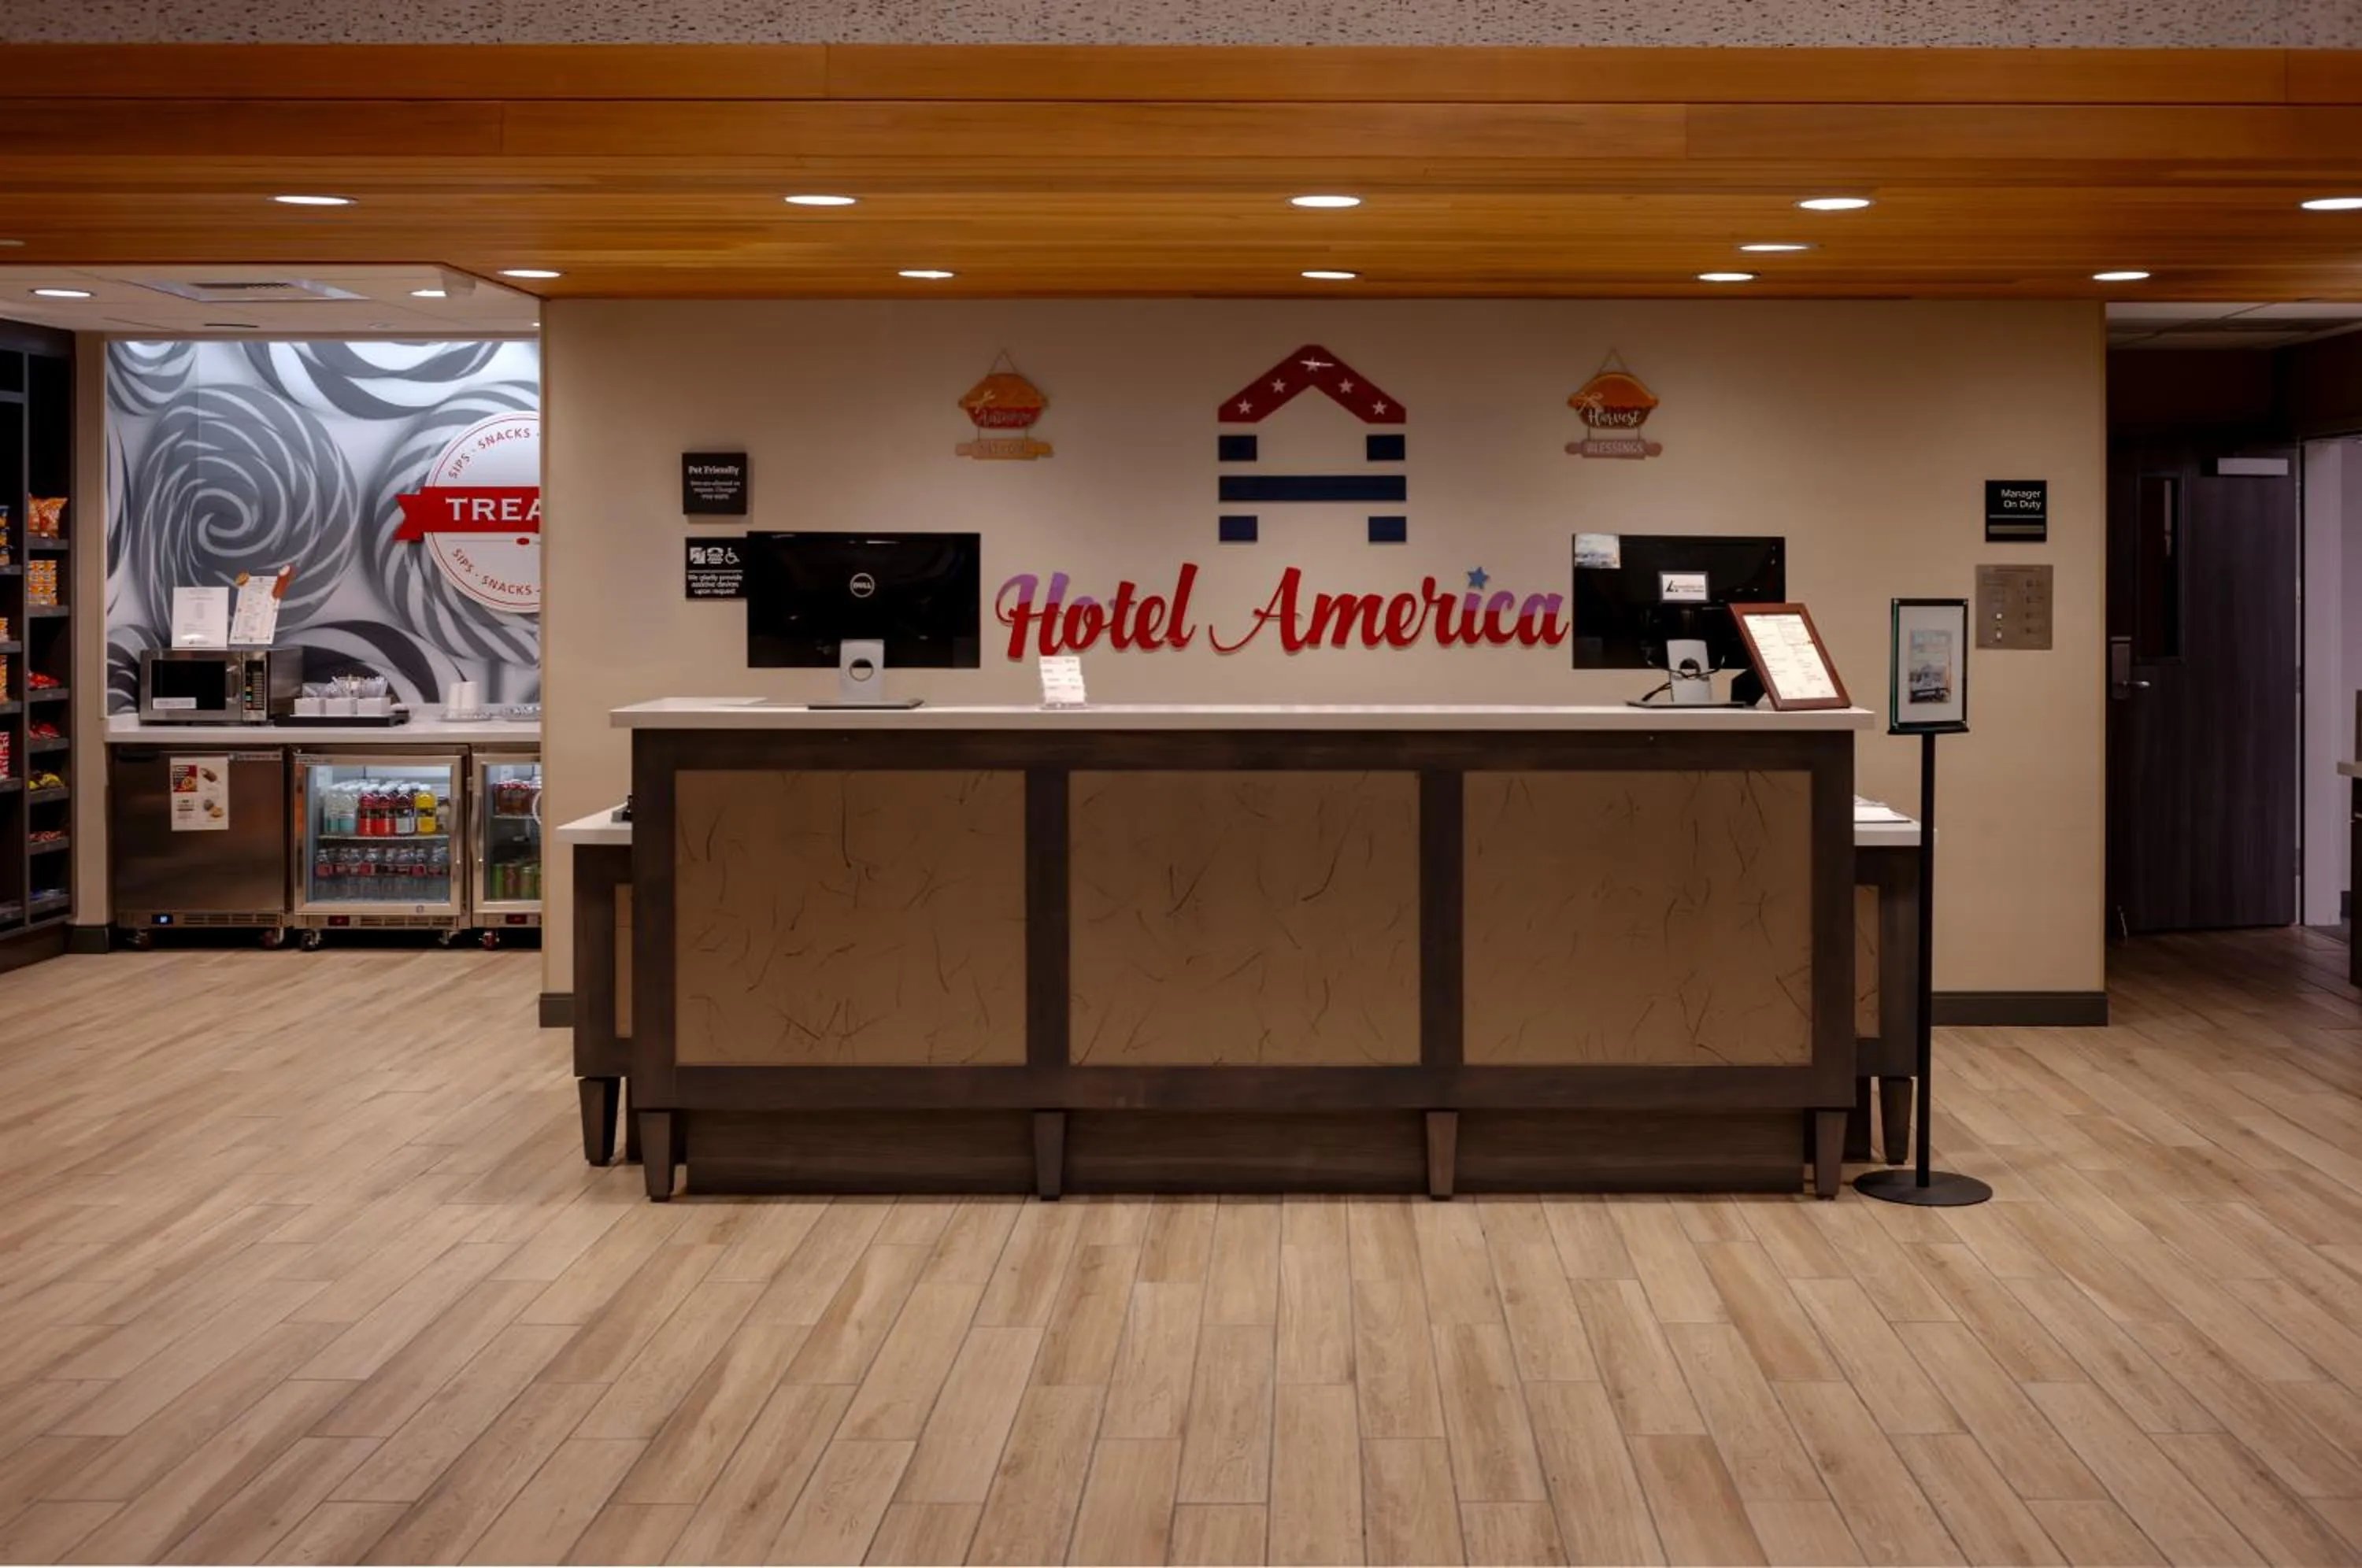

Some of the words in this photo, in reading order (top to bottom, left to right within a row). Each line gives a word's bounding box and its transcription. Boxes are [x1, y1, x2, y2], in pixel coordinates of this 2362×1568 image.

[1589, 409, 1639, 427] Harvest
[448, 453, 471, 479] SIPS
[477, 427, 531, 451] SNACKS
[688, 465, 702, 475] Pet
[2001, 489, 2041, 499] Manager
[2003, 500, 2017, 508] On
[2020, 500, 2042, 511] Duty
[452, 548, 474, 573] SIPS
[481, 575, 533, 597] SNACKS
[995, 562, 1198, 660] Hotel
[1209, 566, 1570, 653] America
